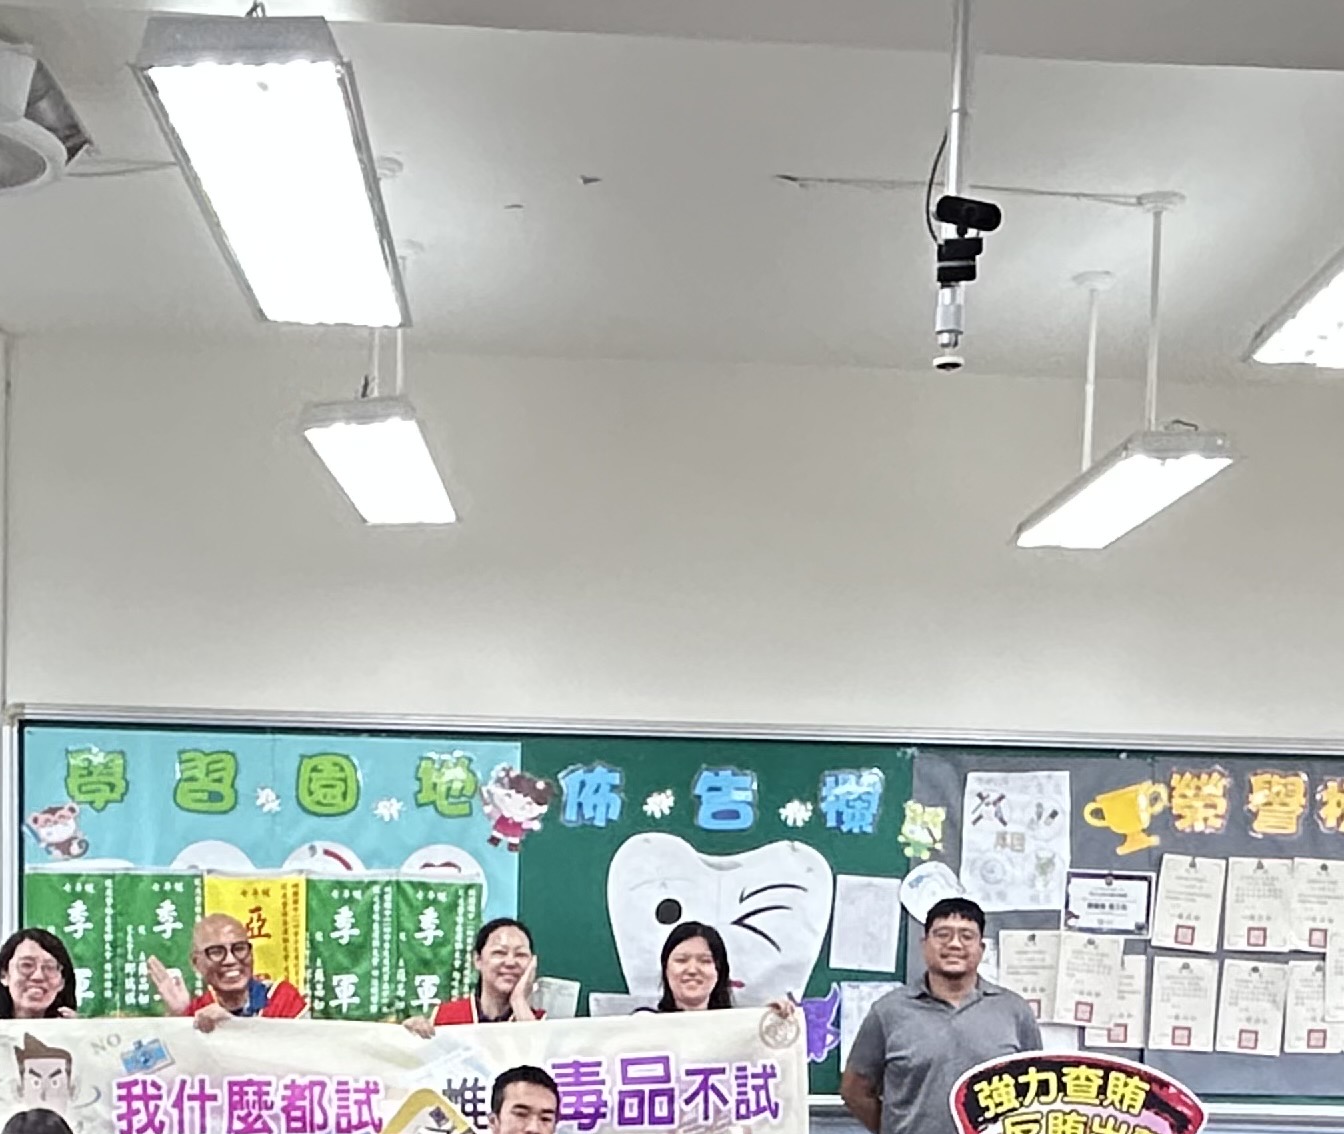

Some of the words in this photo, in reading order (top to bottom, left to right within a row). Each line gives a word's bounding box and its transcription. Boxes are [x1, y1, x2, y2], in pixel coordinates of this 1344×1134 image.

[64, 747, 477, 818] 學習園地
[559, 763, 884, 834] 佈告欄
[329, 905, 361, 1014] 季軍
[411, 906, 445, 1014] 季軍
[973, 1065, 1150, 1117] 強力查賄
